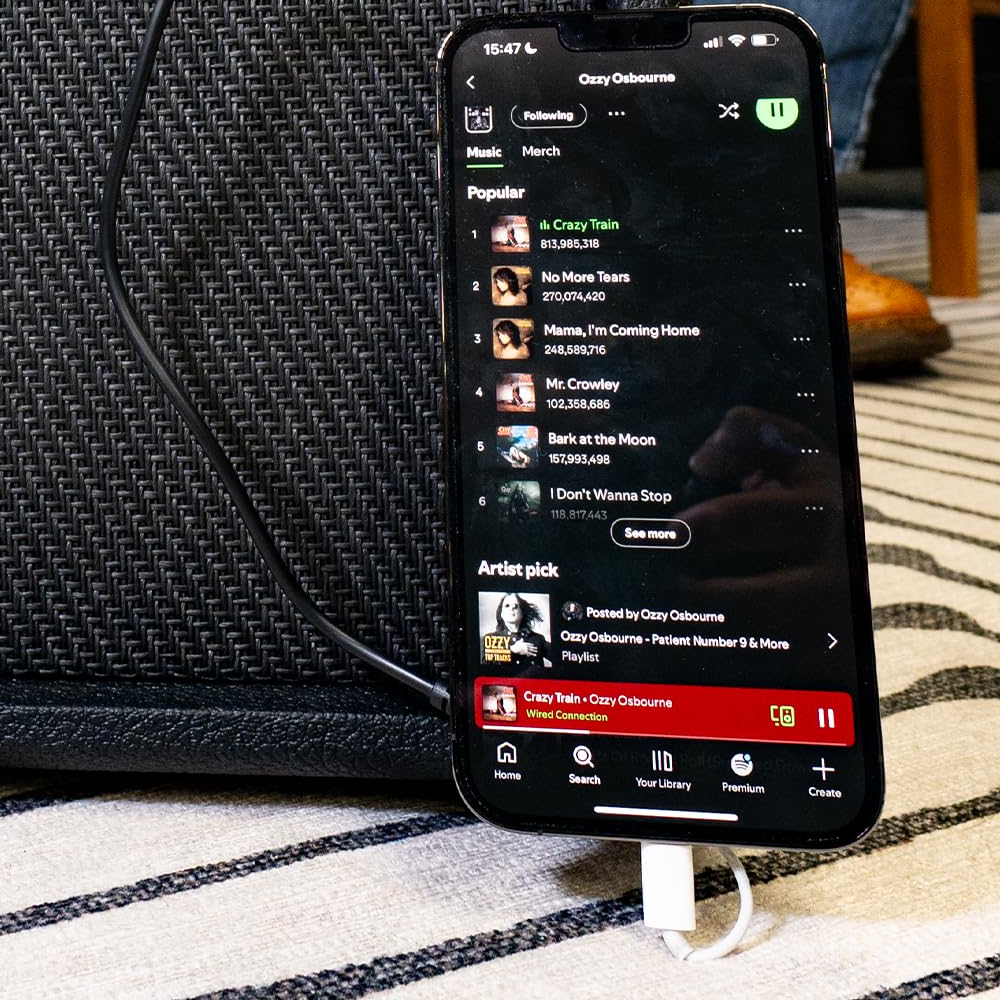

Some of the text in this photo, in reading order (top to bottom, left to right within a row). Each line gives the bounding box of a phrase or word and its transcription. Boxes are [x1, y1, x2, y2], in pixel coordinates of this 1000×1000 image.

[483, 43, 522, 55] 15:47
[578, 72, 675, 86] Ozzy Osbourne
[524, 110, 574, 121] Following
[467, 146, 502, 158] Music
[522, 145, 560, 156] Merch
[468, 185, 525, 202] Popular
[553, 219, 619, 232] Crazy Train
[472, 230, 477, 238] 1
[541, 239, 599, 249] 813,985,318
[542, 271, 630, 283] No More Tears
[472, 281, 479, 291] 2
[542, 292, 605, 304] 270,074,420
[544, 324, 699, 338] Mama, I'm Coming Home
[474, 334, 481, 343] 3
[544, 345, 606, 356] 248,589,716
[546, 378, 620, 392] Mr. Crowley
[476, 387, 482, 397] 4
[546, 399, 610, 410] 102,358,686
[548, 432, 656, 446] Bark at the Moon
[478, 441, 484, 451] 5
[549, 454, 610, 465] 157,993,498
[479, 496, 485, 506] 6
[556, 488, 590, 500] Don't
[592, 489, 638, 501] Wanna
[640, 489, 672, 504] Stop
[624, 527, 676, 539] See more
[478, 560, 559, 580] Artist pick
[587, 607, 724, 622] Posted by Ozzy Osbourne
[485, 635, 511, 649] OZZY
[561, 630, 587, 644] Ozzy
[589, 632, 643, 644] Osbourne
[652, 634, 696, 646] Patient
[698, 636, 737, 647] Number
[739, 637, 746, 648] 9
[749, 637, 758, 648] &
[760, 638, 789, 649] More
[562, 651, 599, 663] Playlist
[524, 691, 672, 708] Crazy Train Ozzy Osbourne
[526, 709, 608, 721] Wired Connection
[494, 769, 521, 780] Home
[569, 774, 601, 784] Search
[636, 777, 691, 791] Your Library
[722, 782, 764, 793] Premium
[809, 787, 842, 797] Create
